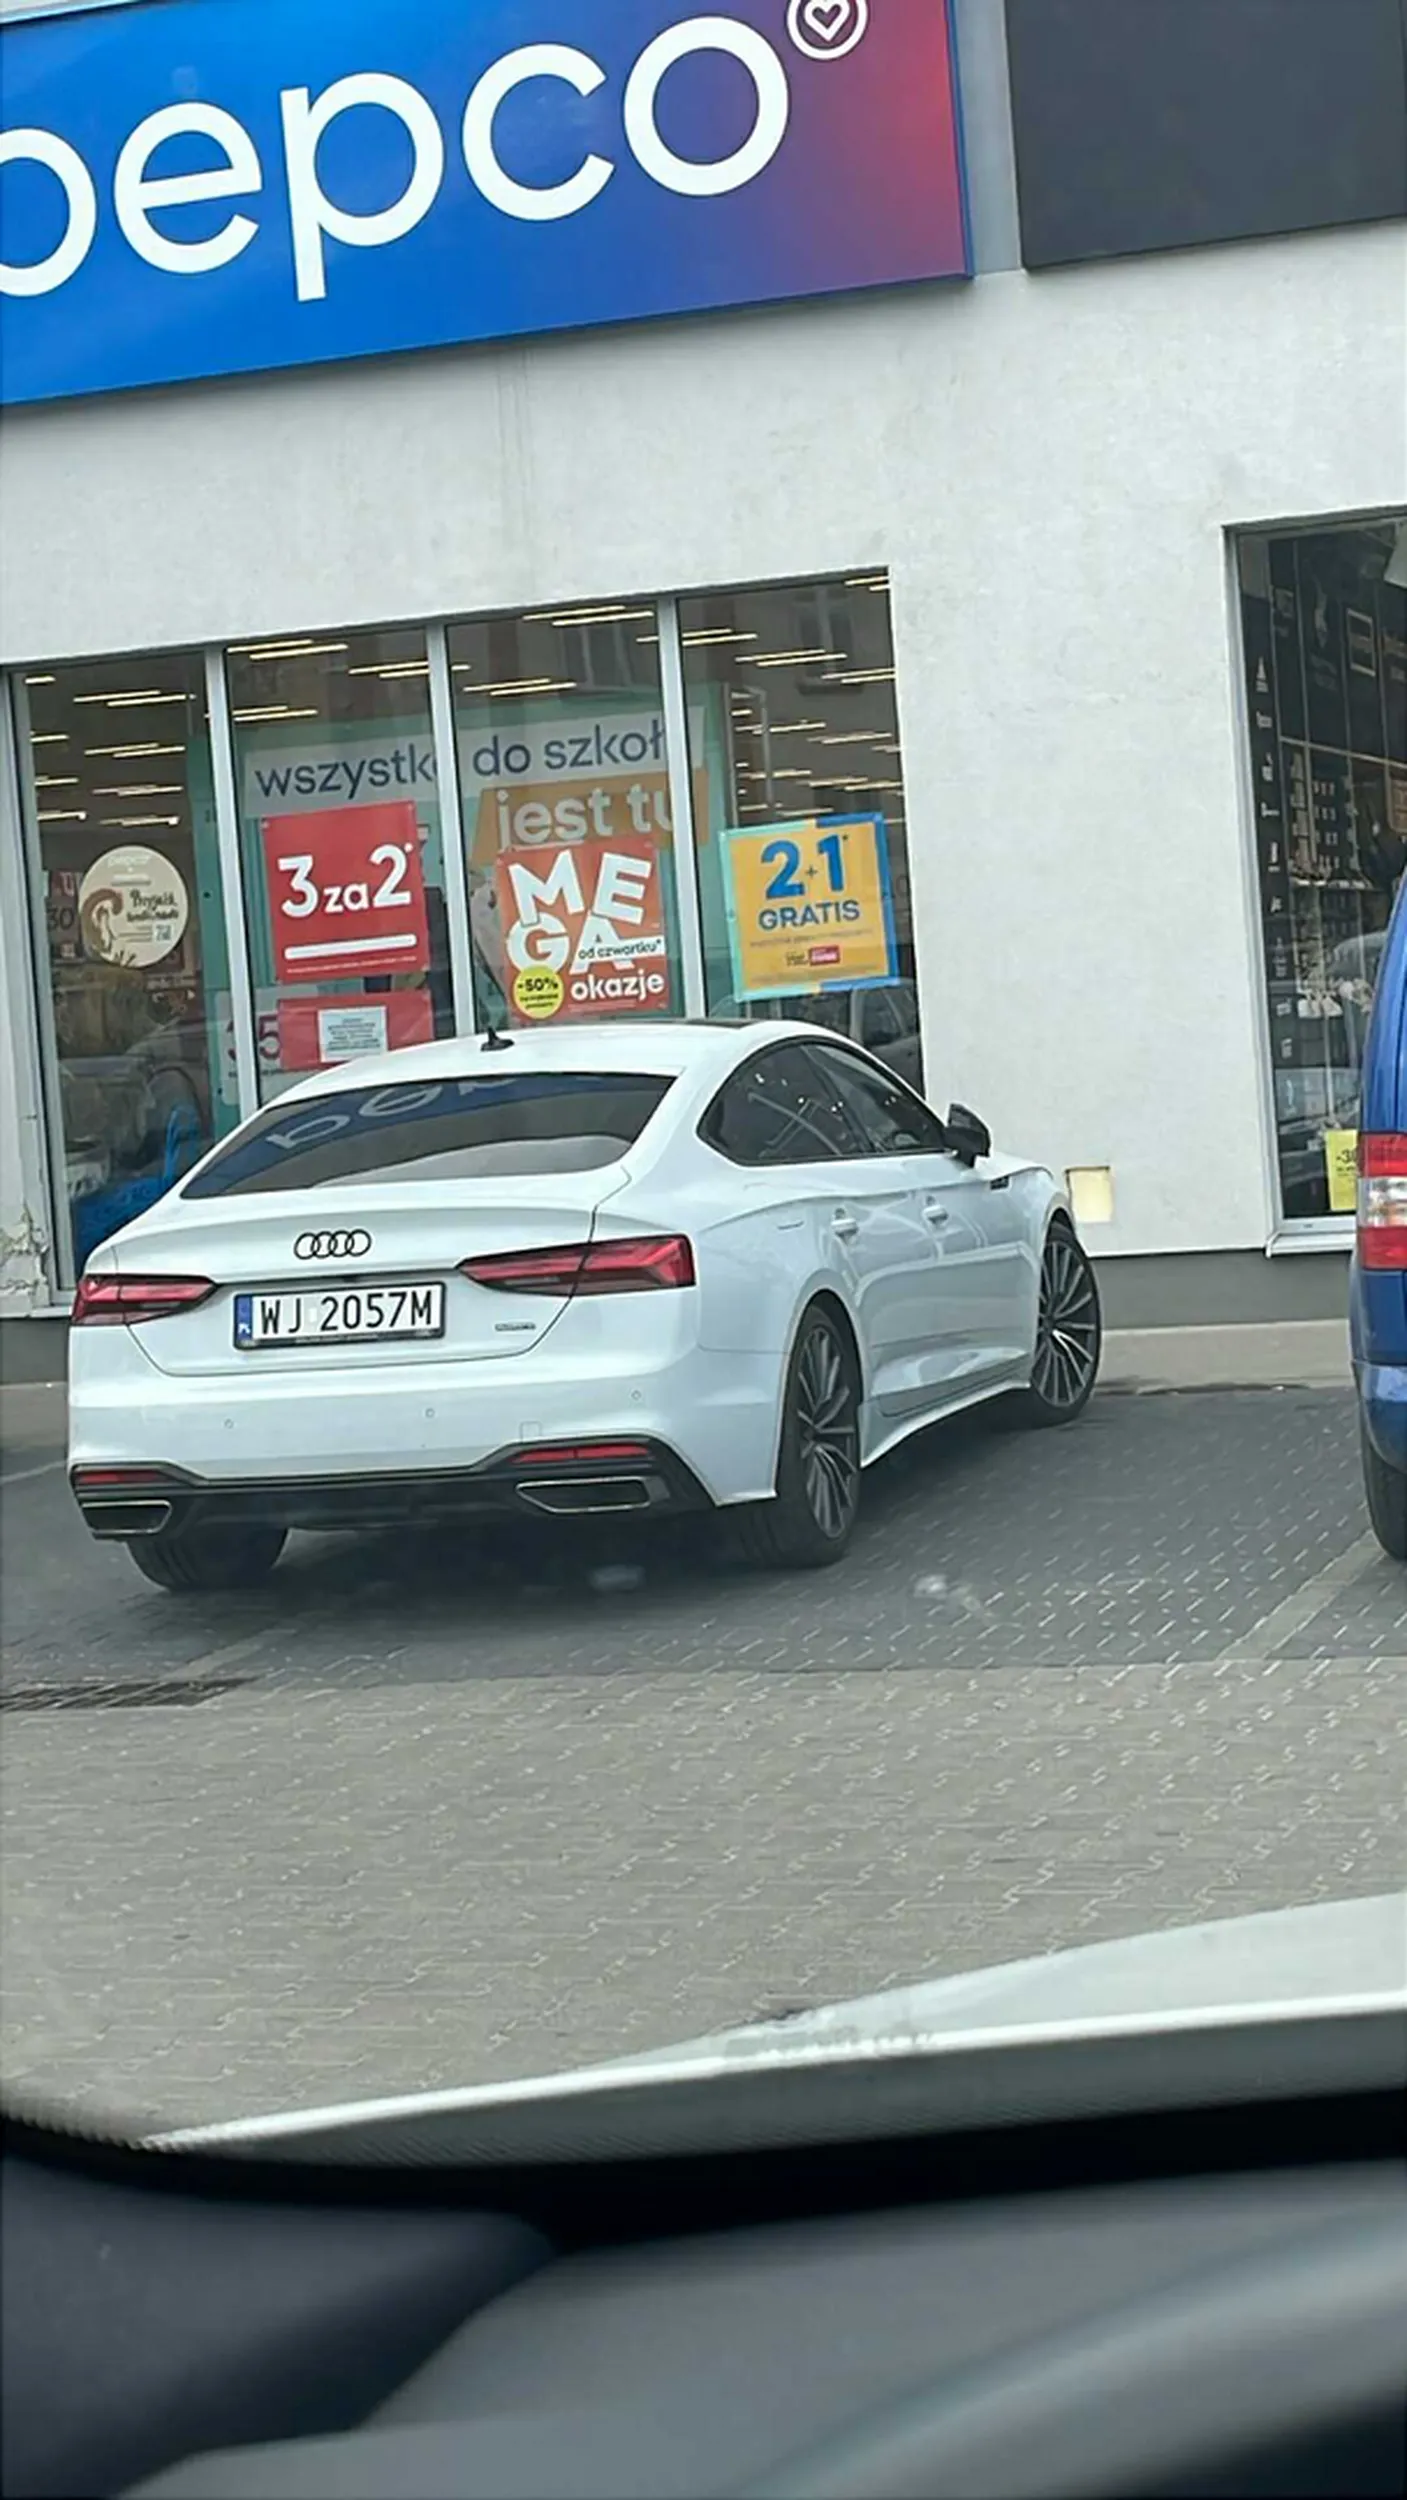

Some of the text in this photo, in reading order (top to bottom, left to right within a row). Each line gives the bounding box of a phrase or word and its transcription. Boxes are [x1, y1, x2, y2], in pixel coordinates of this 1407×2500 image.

[254, 719, 667, 800] wszystk do szkoł
[497, 786, 613, 854] jest
[278, 855, 318, 918] 3
[325, 887, 369, 914] za
[758, 900, 861, 930] GRATIS
[578, 947, 595, 960] od
[517, 976, 559, 992] -50%
[570, 968, 665, 1001] okazje
[260, 1290, 433, 1335] WJ 2057M
